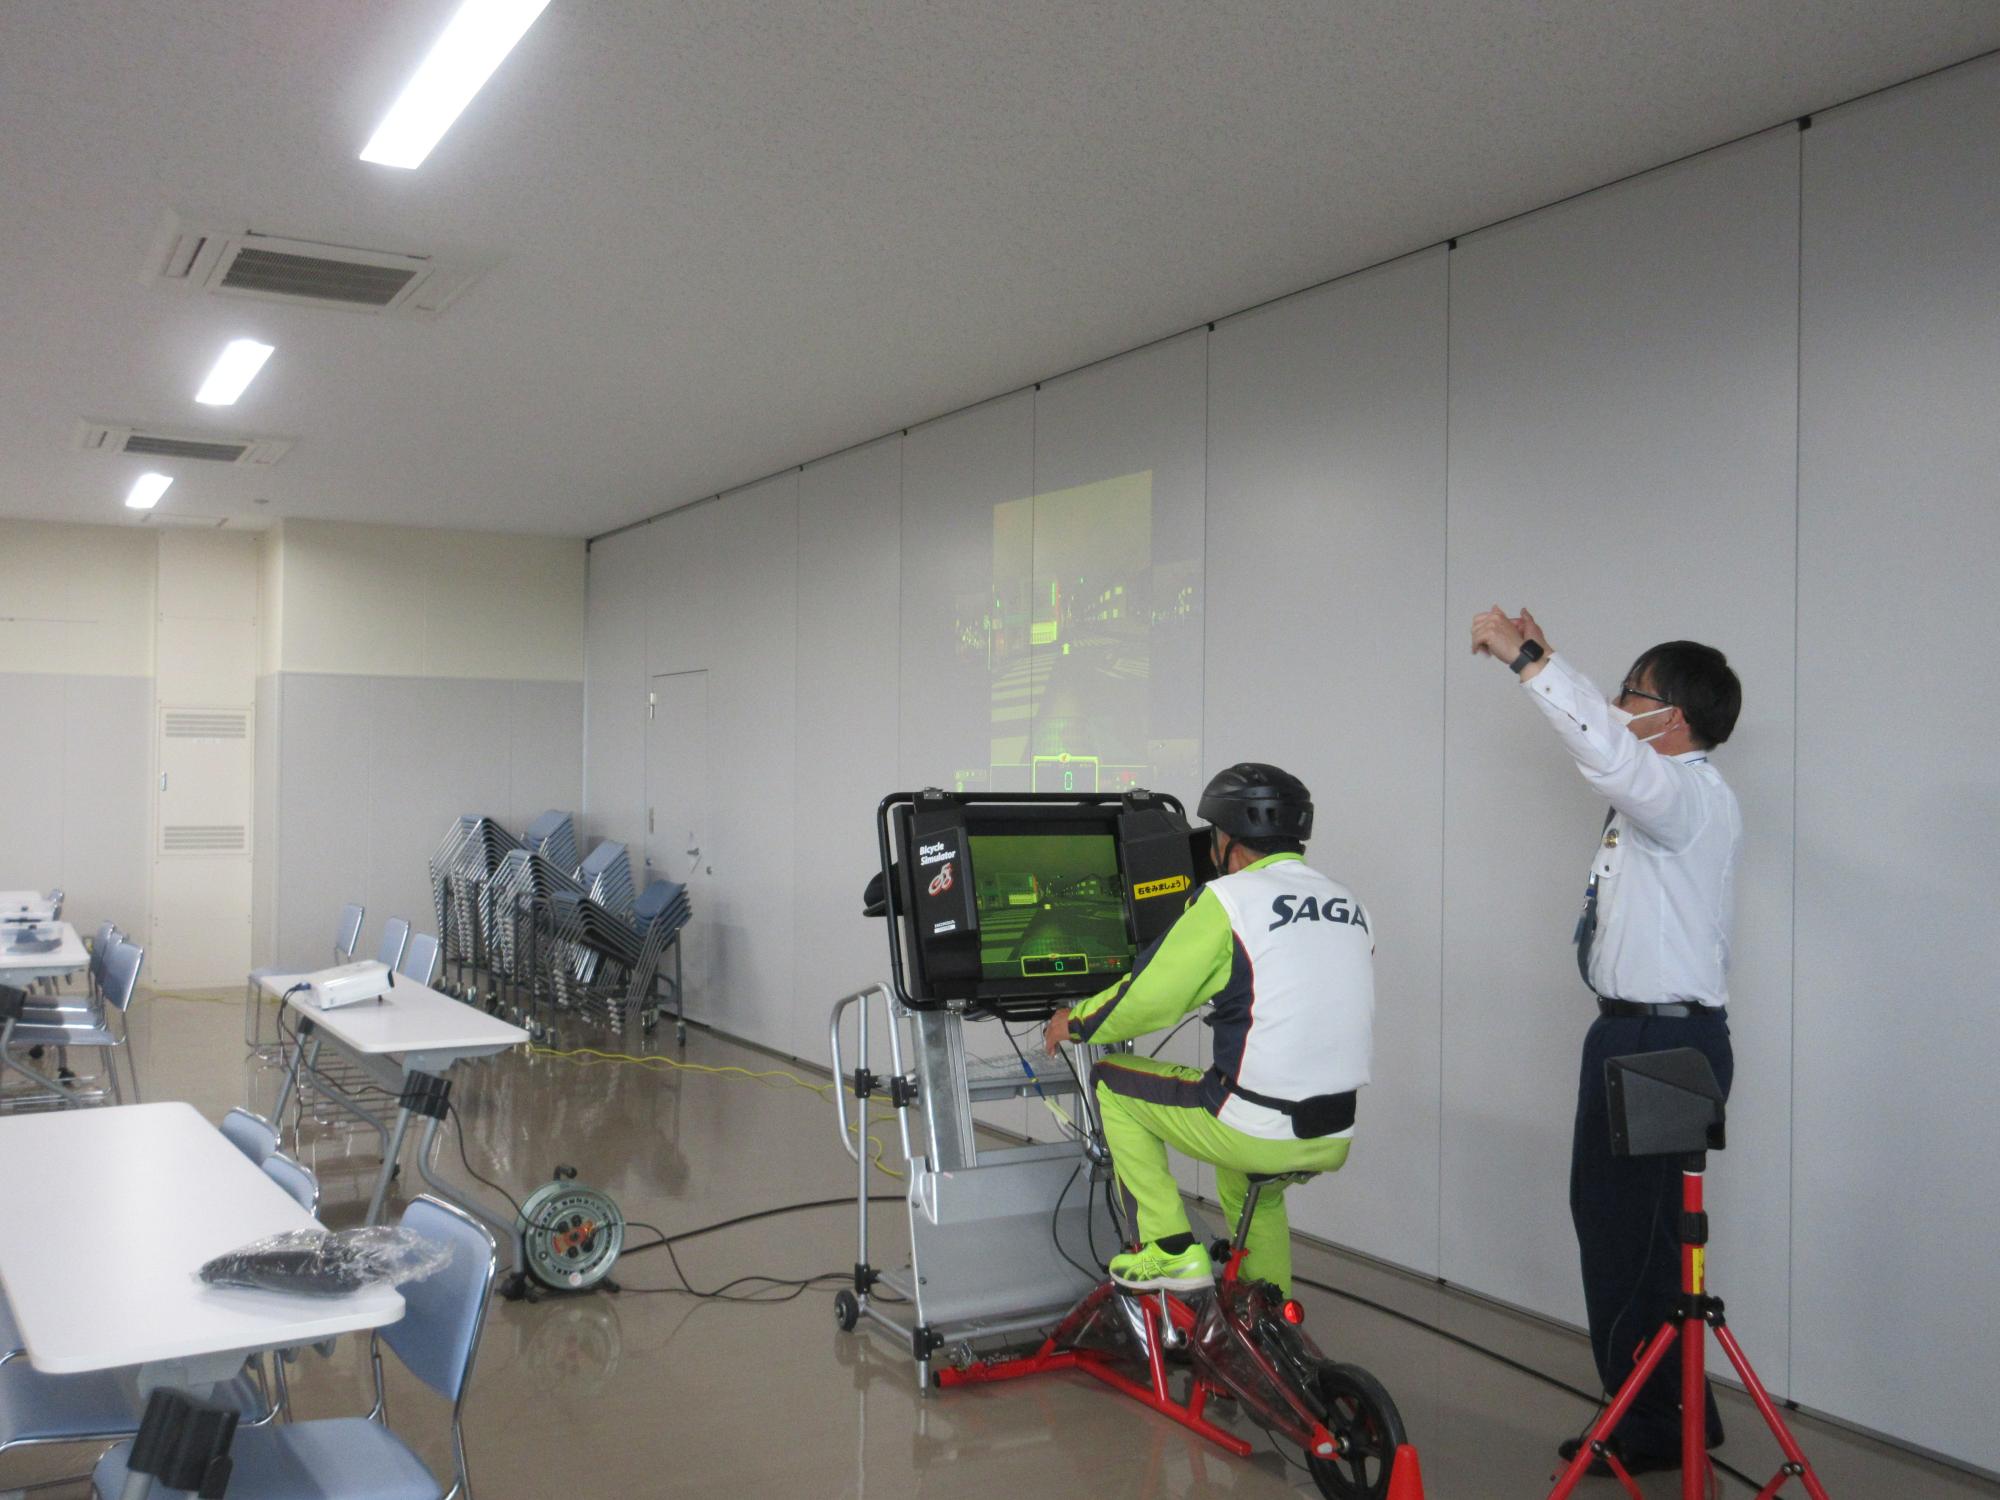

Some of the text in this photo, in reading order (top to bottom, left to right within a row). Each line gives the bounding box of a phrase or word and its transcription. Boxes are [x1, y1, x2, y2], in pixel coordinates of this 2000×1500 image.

[919, 841, 945, 856] Bicycle
[920, 850, 956, 866] Simulator
[1269, 894, 1369, 935] SAGA
